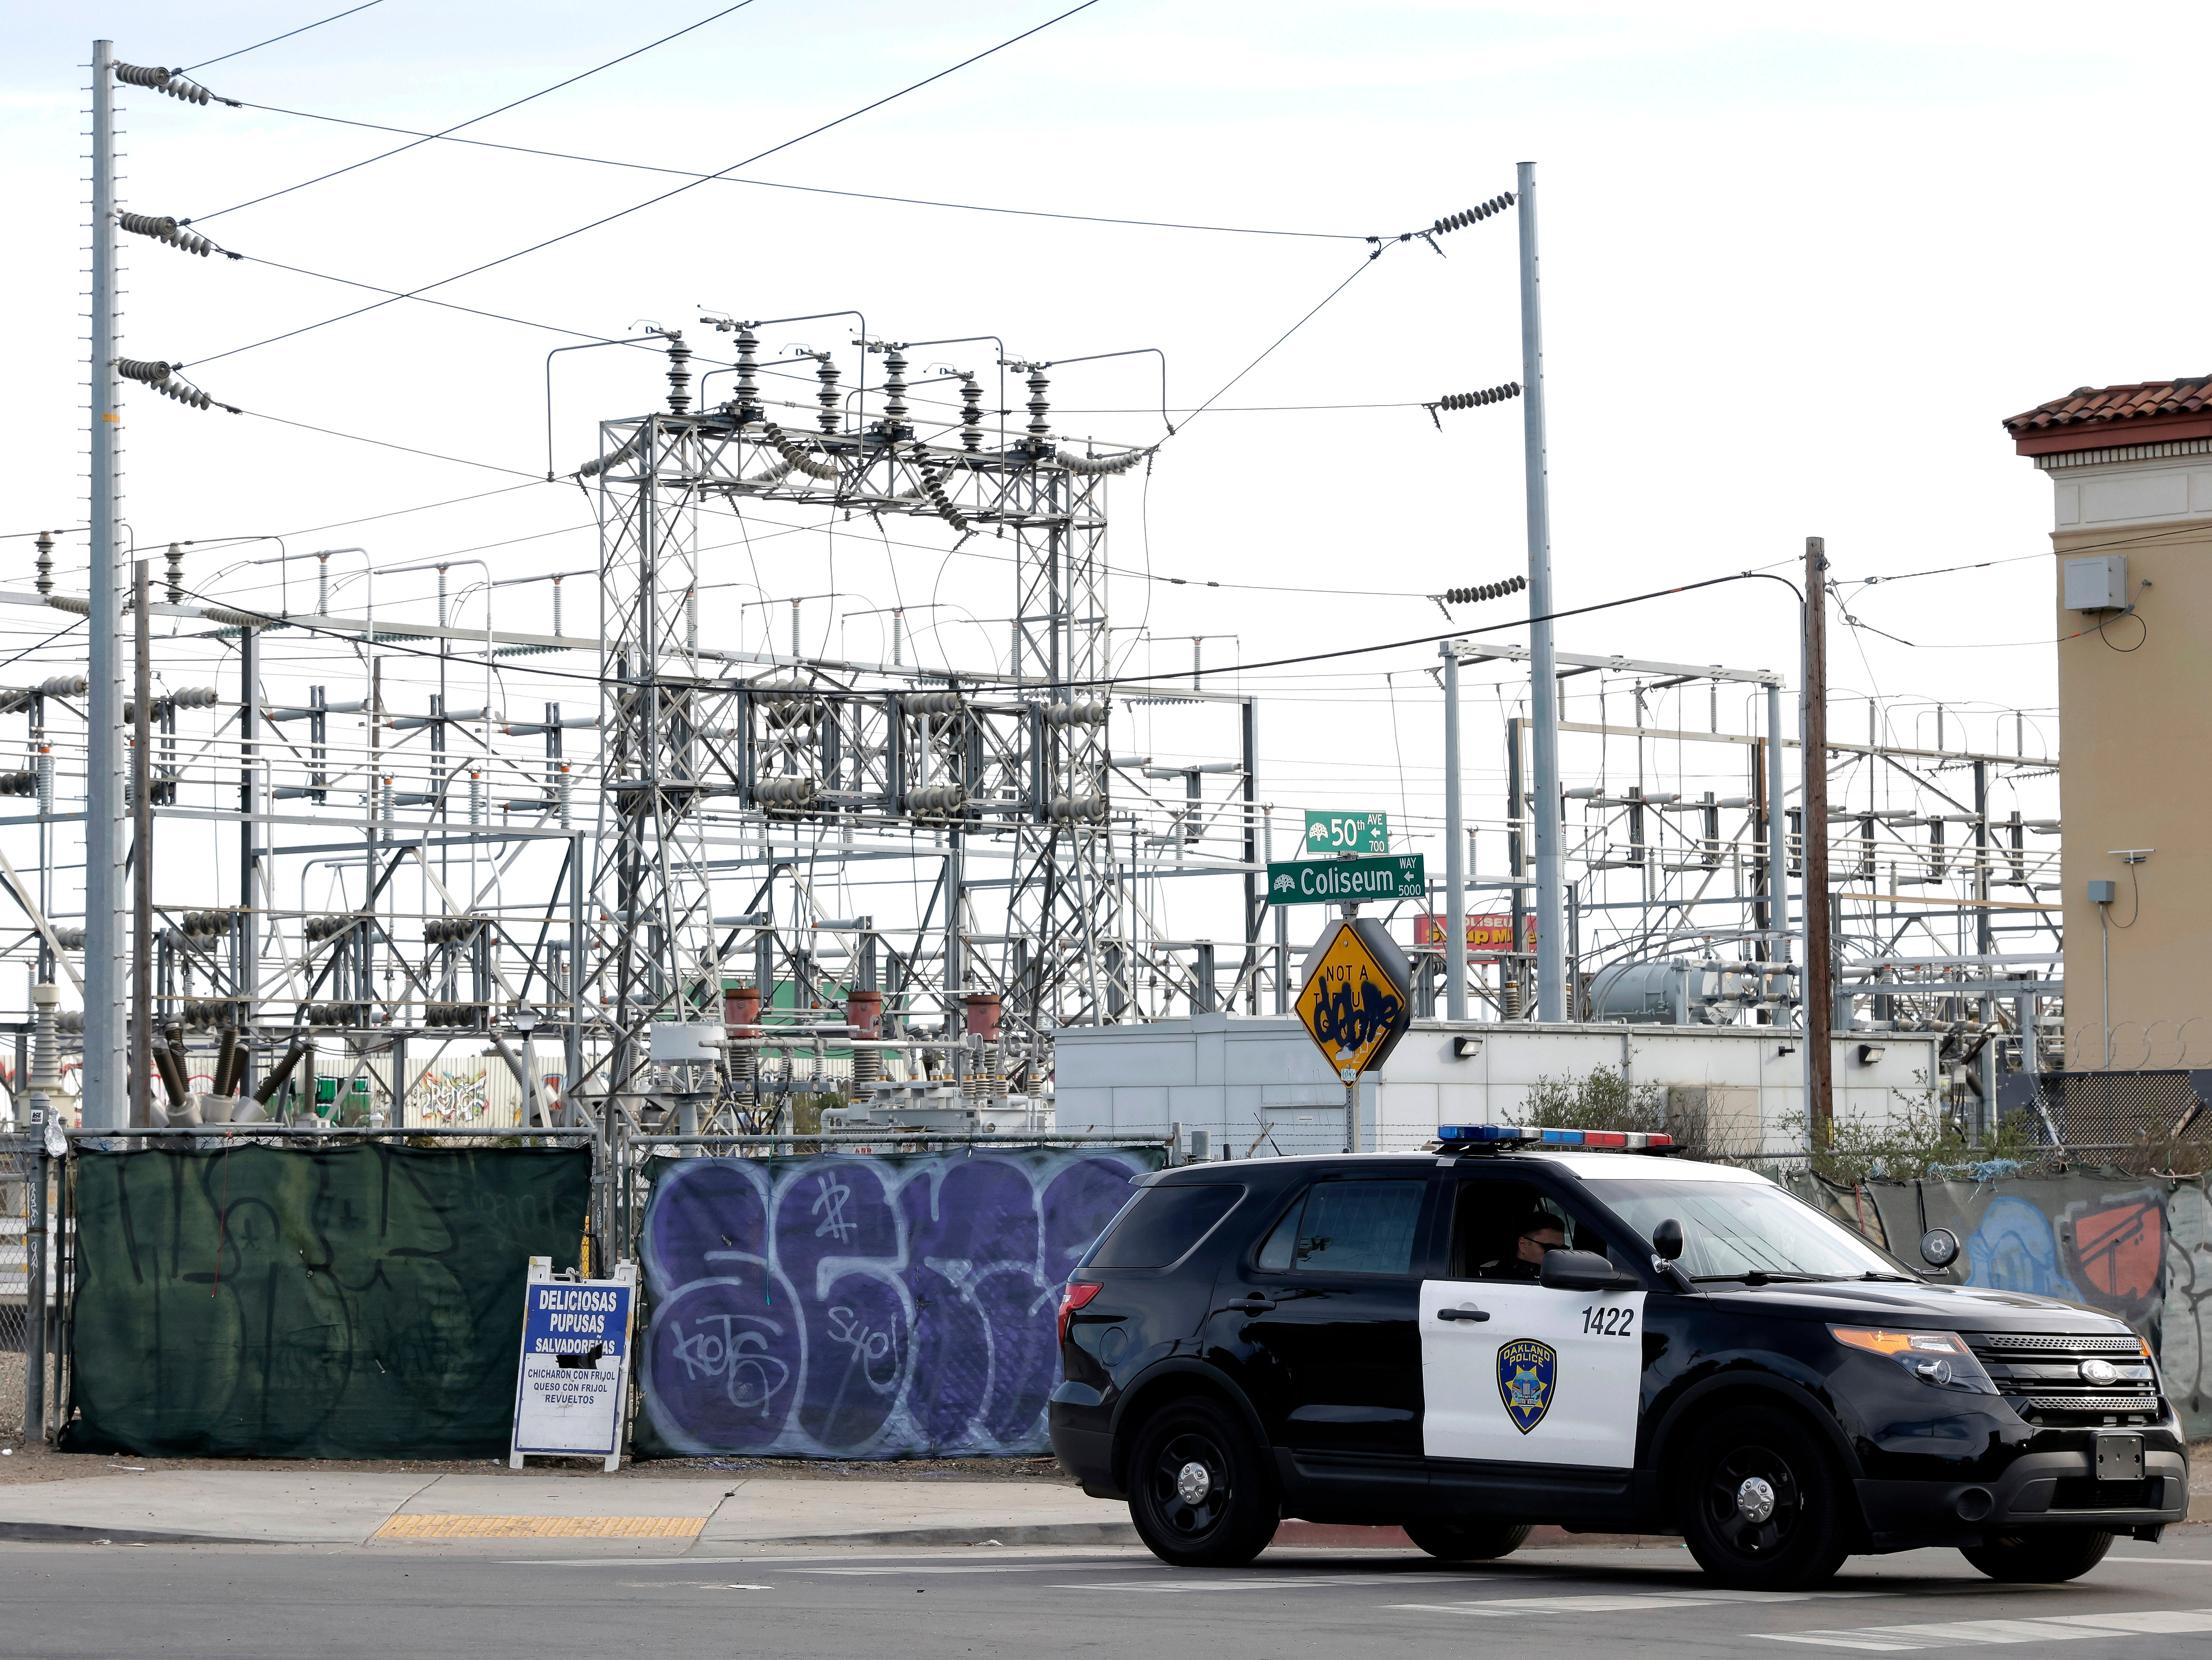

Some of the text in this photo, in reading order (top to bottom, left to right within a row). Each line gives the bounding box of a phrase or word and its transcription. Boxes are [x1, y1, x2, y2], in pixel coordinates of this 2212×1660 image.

[1331, 814, 1383, 846] 50th AVE
[1368, 840, 1385, 852] 700
[1399, 857, 1417, 869] WAY
[1301, 867, 1393, 895] Coliseum
[1398, 884, 1421, 896] 5000
[1326, 964, 1369, 982] NOT A
[539, 1290, 617, 1312] DELICIOSAS
[549, 1313, 605, 1333] PUPUSAS
[1582, 1306, 1634, 1337] 1422
[1504, 1344, 1550, 1361] OAKLAND
[1509, 1353, 1544, 1368] POLICE
[528, 1369, 615, 1380] CHICHARON CON FRIJOL
[534, 1382, 607, 1392] QUESO CON FRIJOL
[545, 1394, 594, 1404] REVUELTOS
